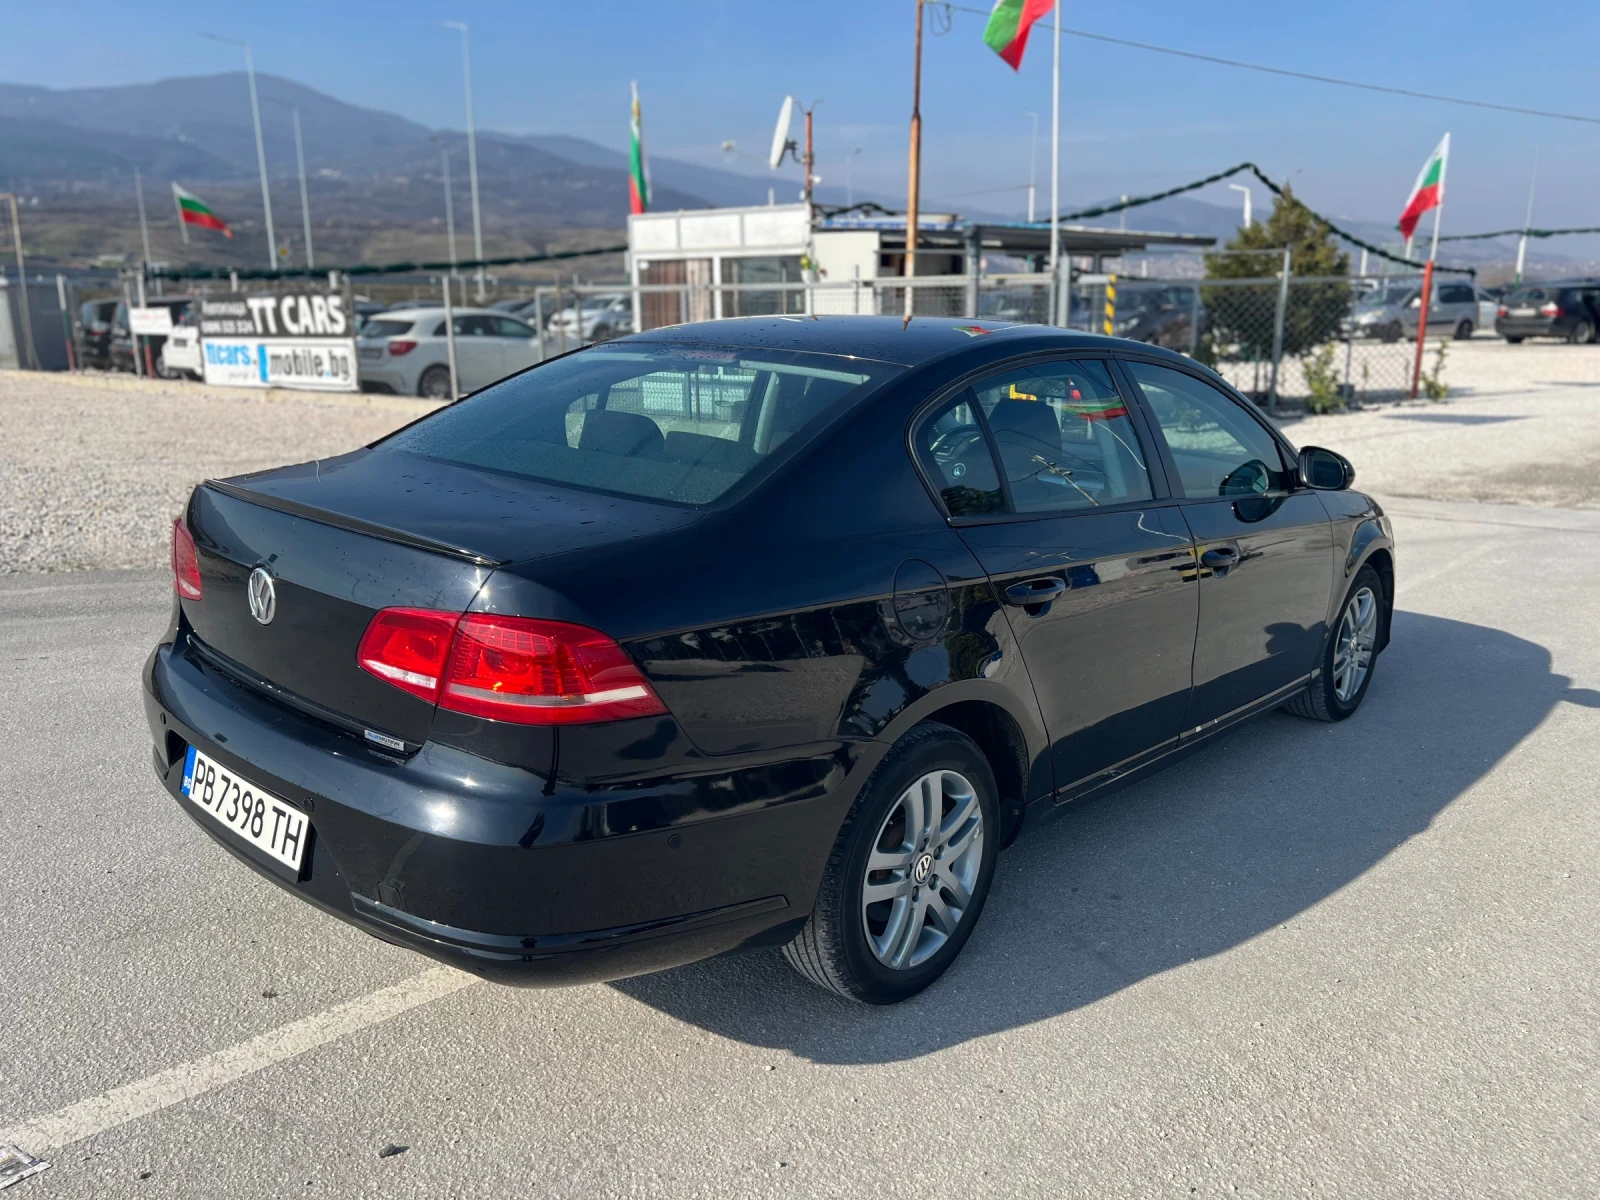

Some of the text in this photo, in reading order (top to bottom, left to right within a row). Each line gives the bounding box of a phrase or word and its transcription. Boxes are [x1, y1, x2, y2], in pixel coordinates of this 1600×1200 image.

[246, 297, 278, 335] TT
[280, 294, 347, 335] CARS
[269, 348, 350, 381] mobile.bg
[183, 775, 192, 790] BG
[192, 757, 303, 862] PB 7398 TH
